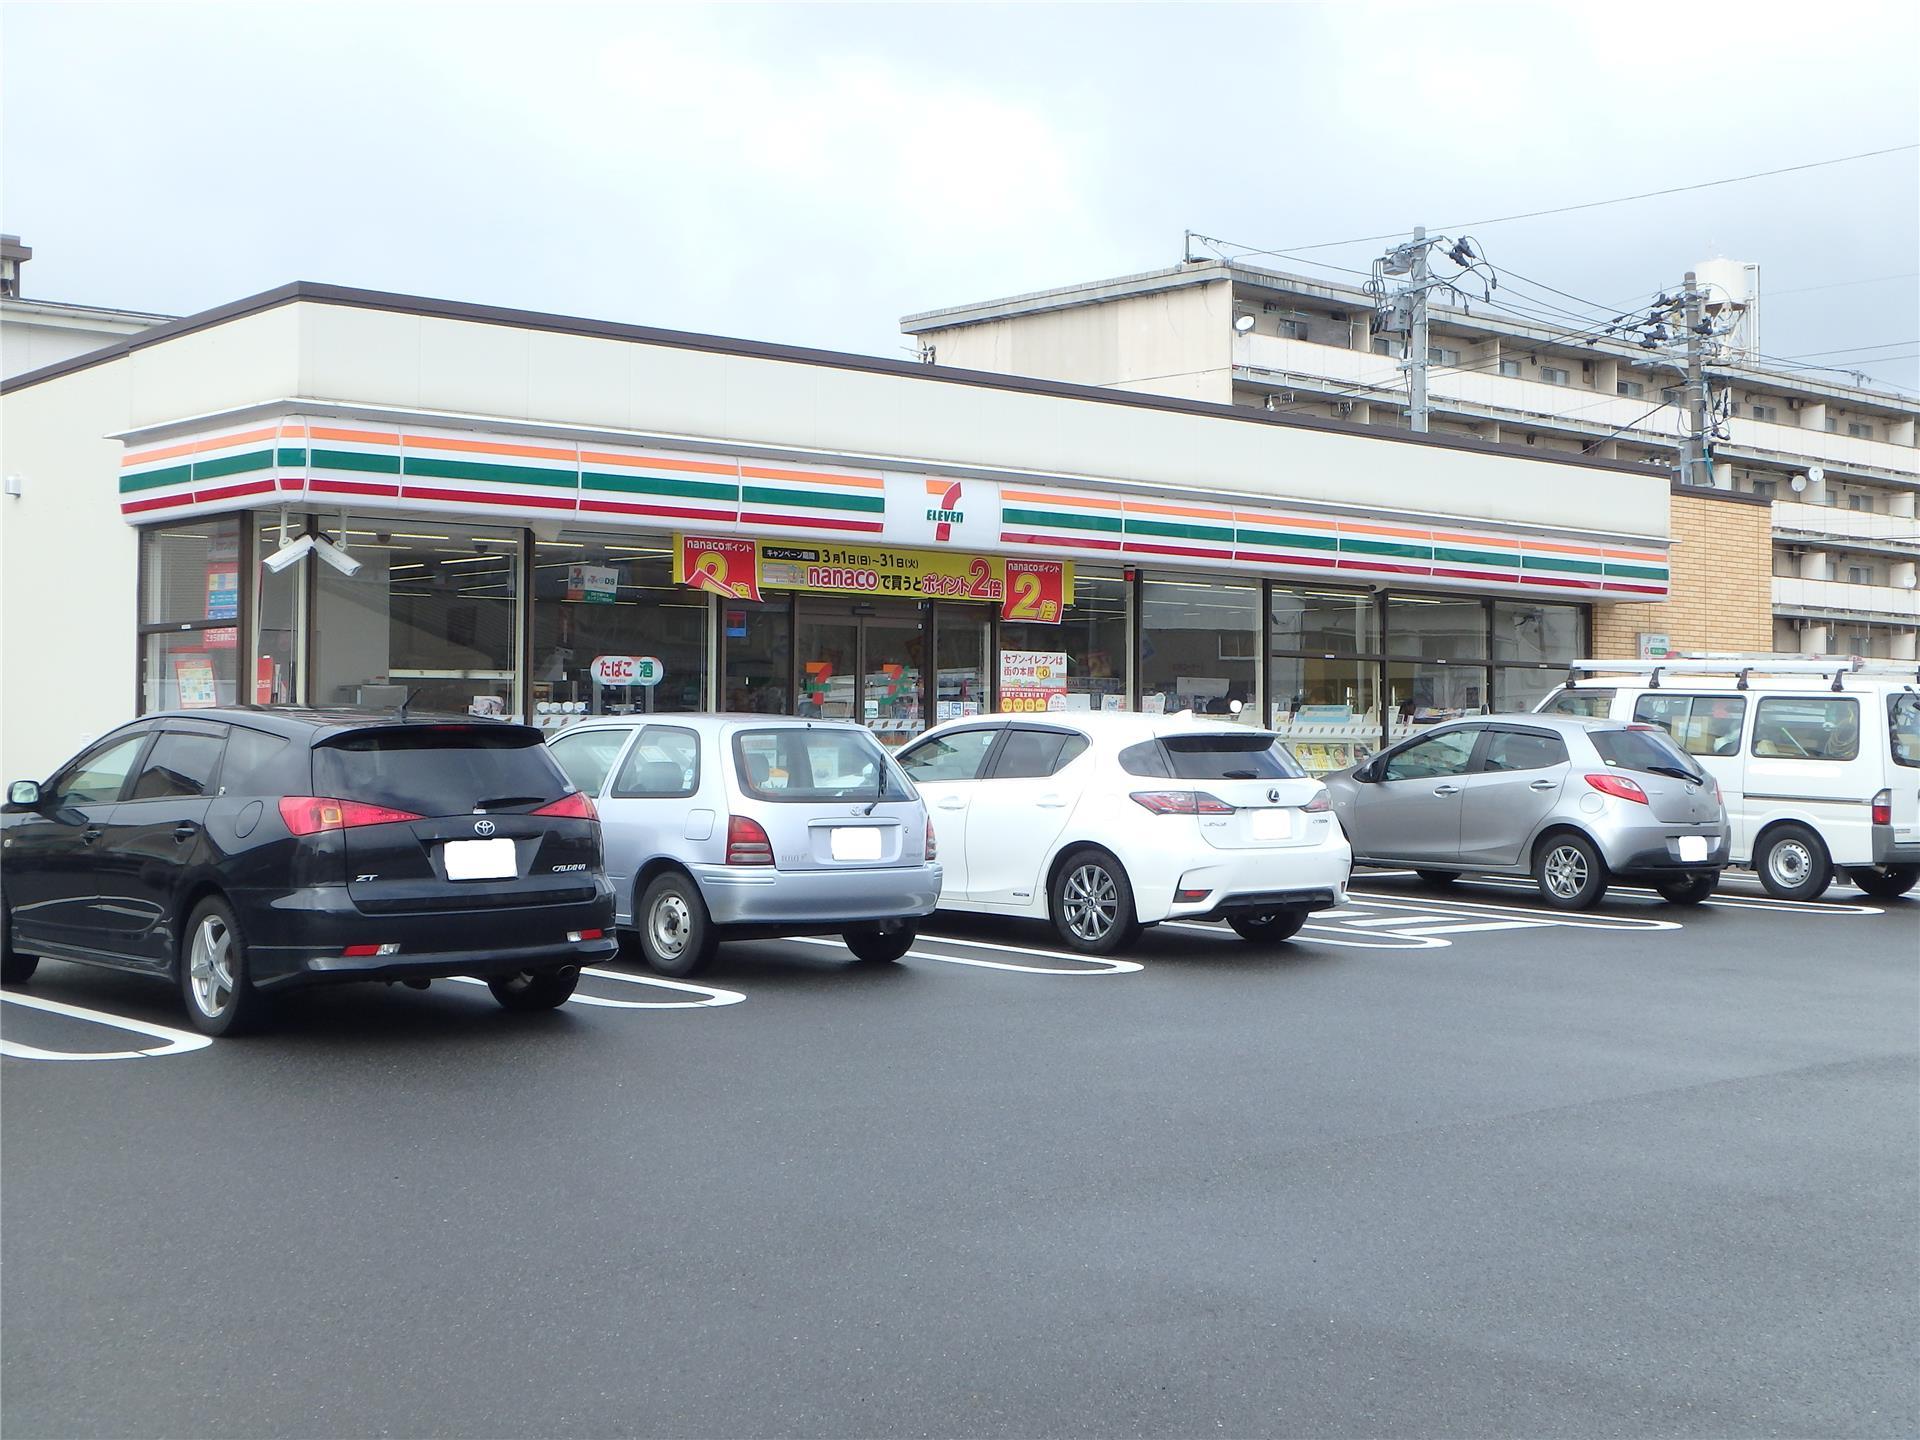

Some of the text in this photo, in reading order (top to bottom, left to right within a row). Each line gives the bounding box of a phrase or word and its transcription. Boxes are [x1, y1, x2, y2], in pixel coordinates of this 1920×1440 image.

[600, 660, 654, 678] たばこ 酒
[355, 874, 378, 882] ZT
